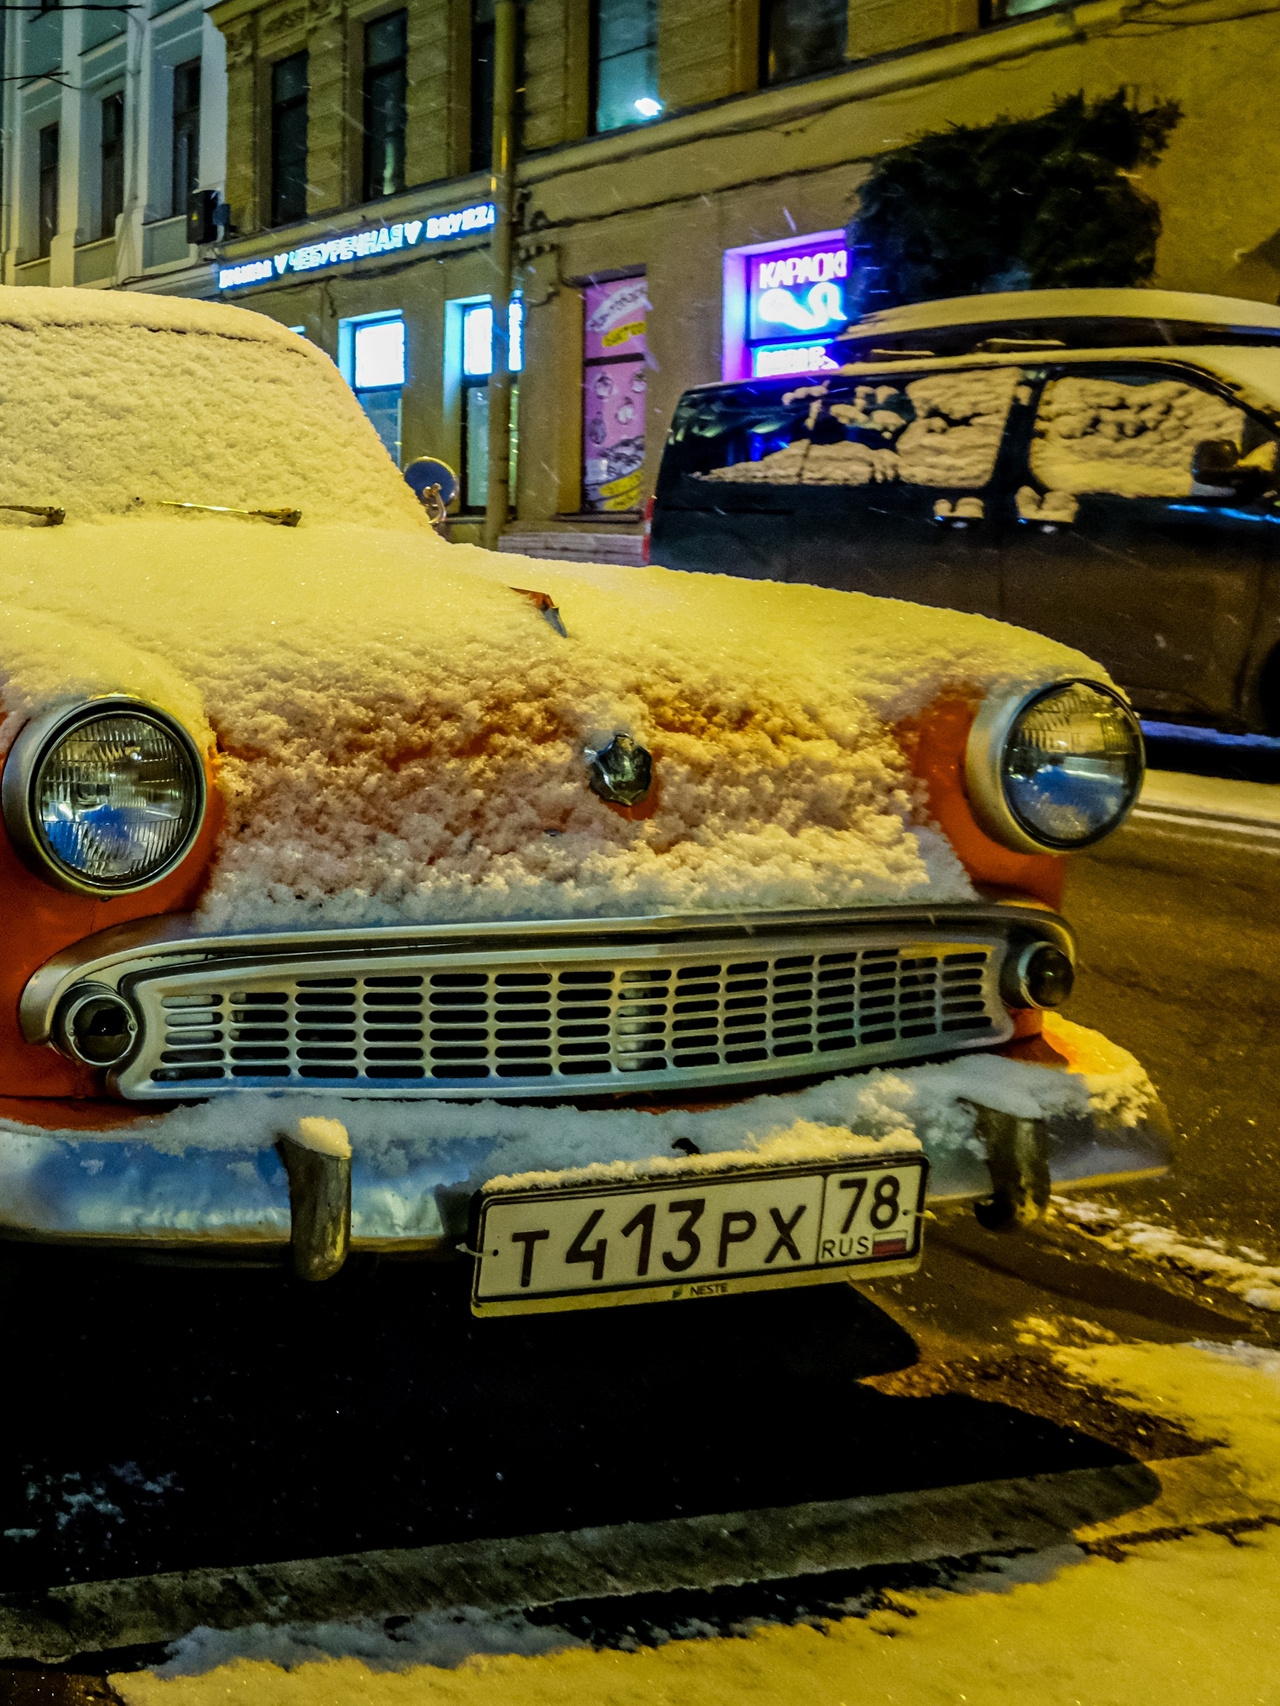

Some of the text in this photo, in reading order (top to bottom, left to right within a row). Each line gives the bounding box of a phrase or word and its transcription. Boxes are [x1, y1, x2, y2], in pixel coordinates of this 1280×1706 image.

[288, 223, 404, 272] ЧЕБУРЕЧНАЯ
[510, 1174, 901, 1288] Т413РХ 78
[821, 1235, 871, 1258] RUS
[690, 1282, 729, 1296] NESTE
